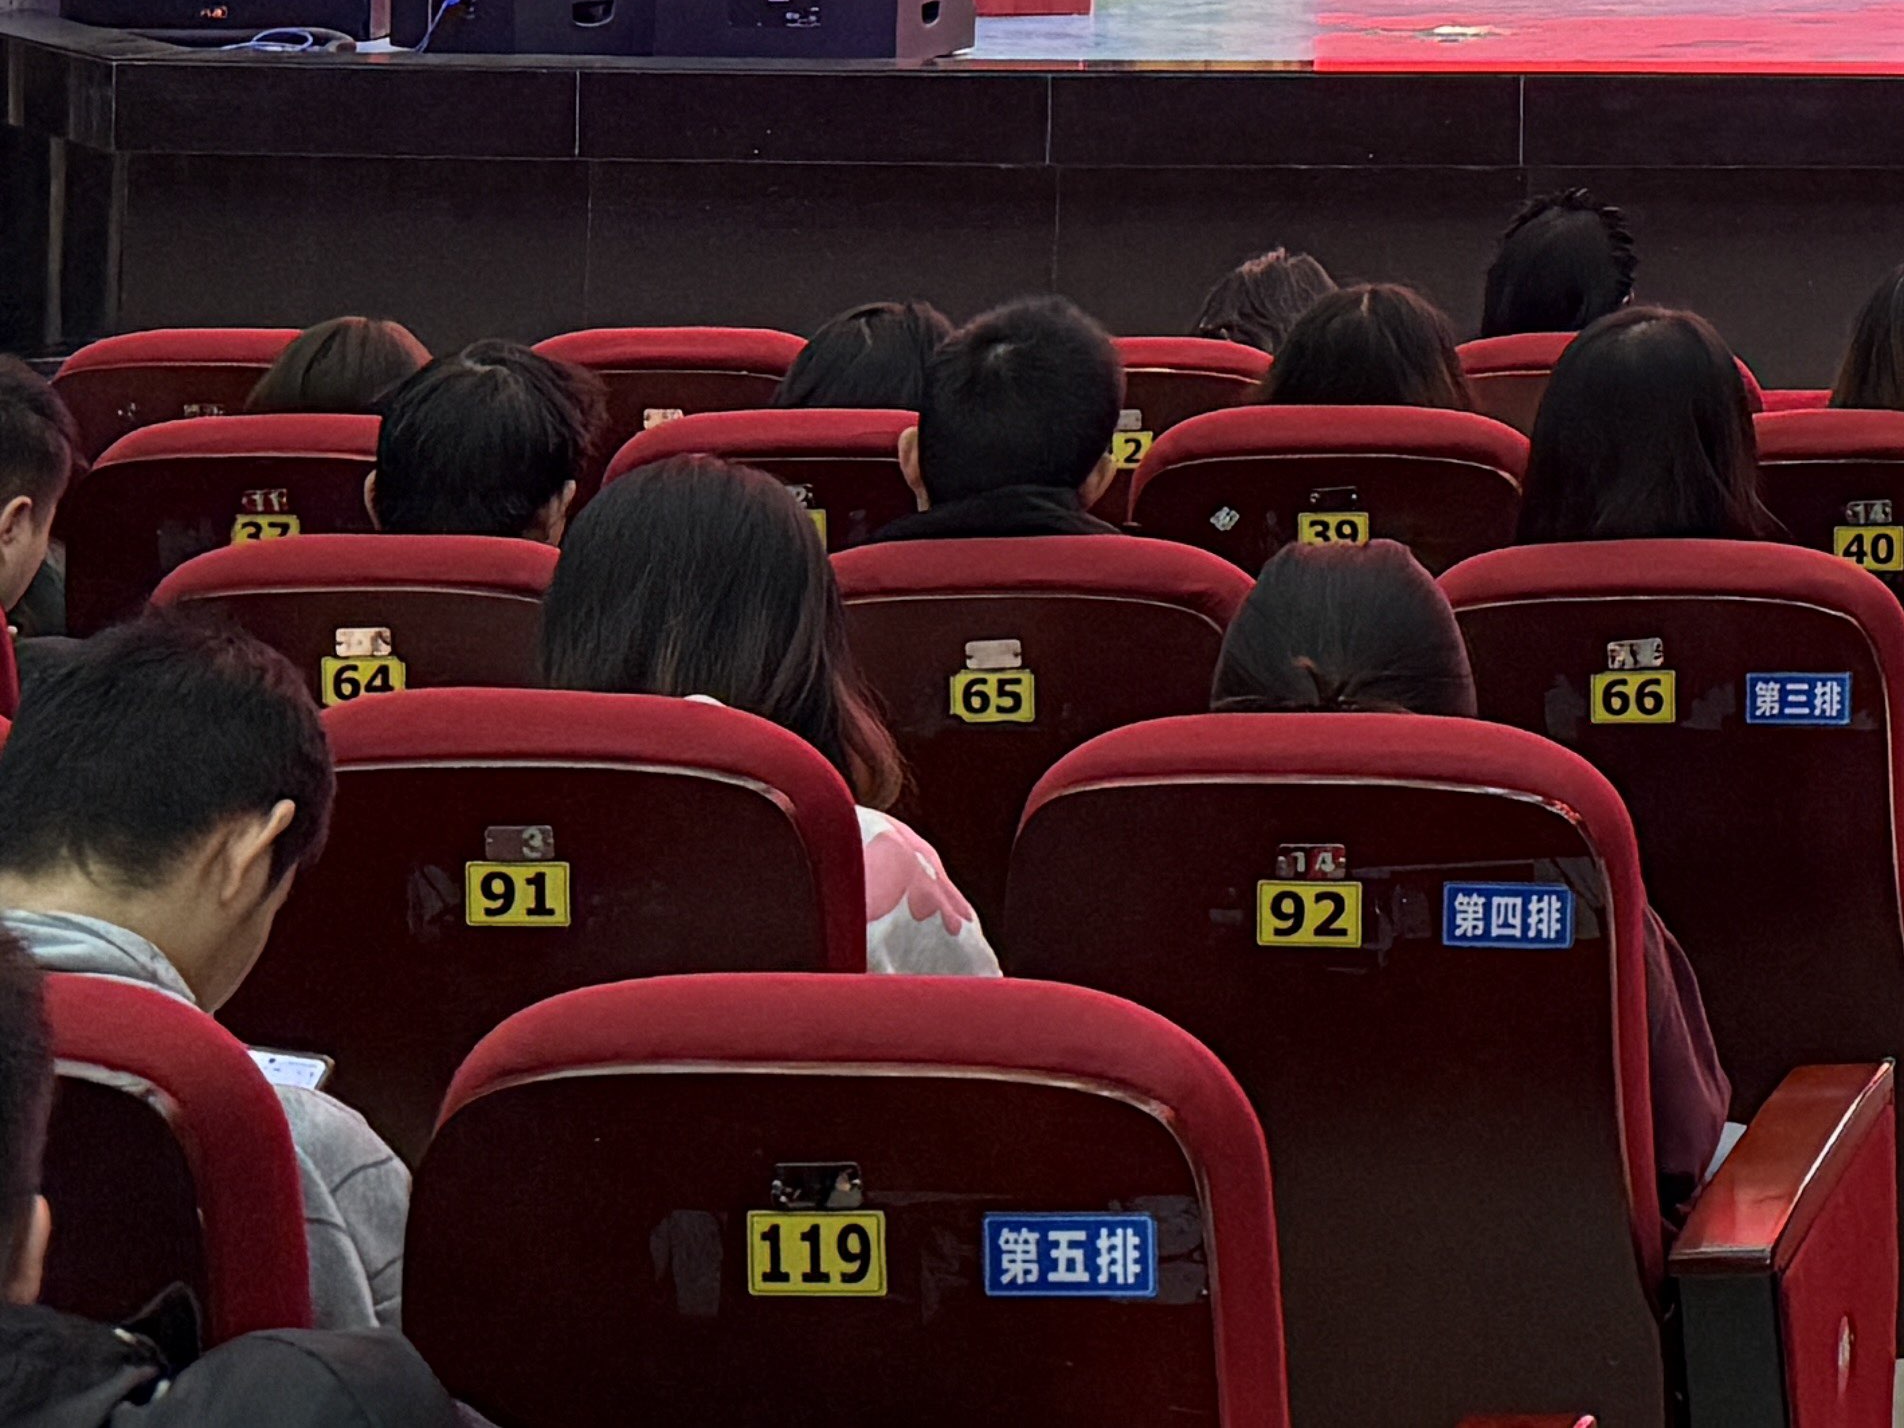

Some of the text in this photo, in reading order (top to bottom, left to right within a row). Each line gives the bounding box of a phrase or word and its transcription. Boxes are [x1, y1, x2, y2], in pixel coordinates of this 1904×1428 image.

[1308, 519, 1359, 543] 39
[1842, 532, 1895, 565] 40
[332, 663, 395, 702] 64
[961, 677, 1023, 716] 65
[1601, 677, 1665, 717] 66
[1754, 680, 1842, 717] 第三排
[480, 871, 556, 918] 91
[1268, 890, 1350, 938] 92
[1453, 893, 1562, 939] 第四排
[760, 1223, 873, 1284] 119
[998, 1227, 1142, 1285] 第五排
